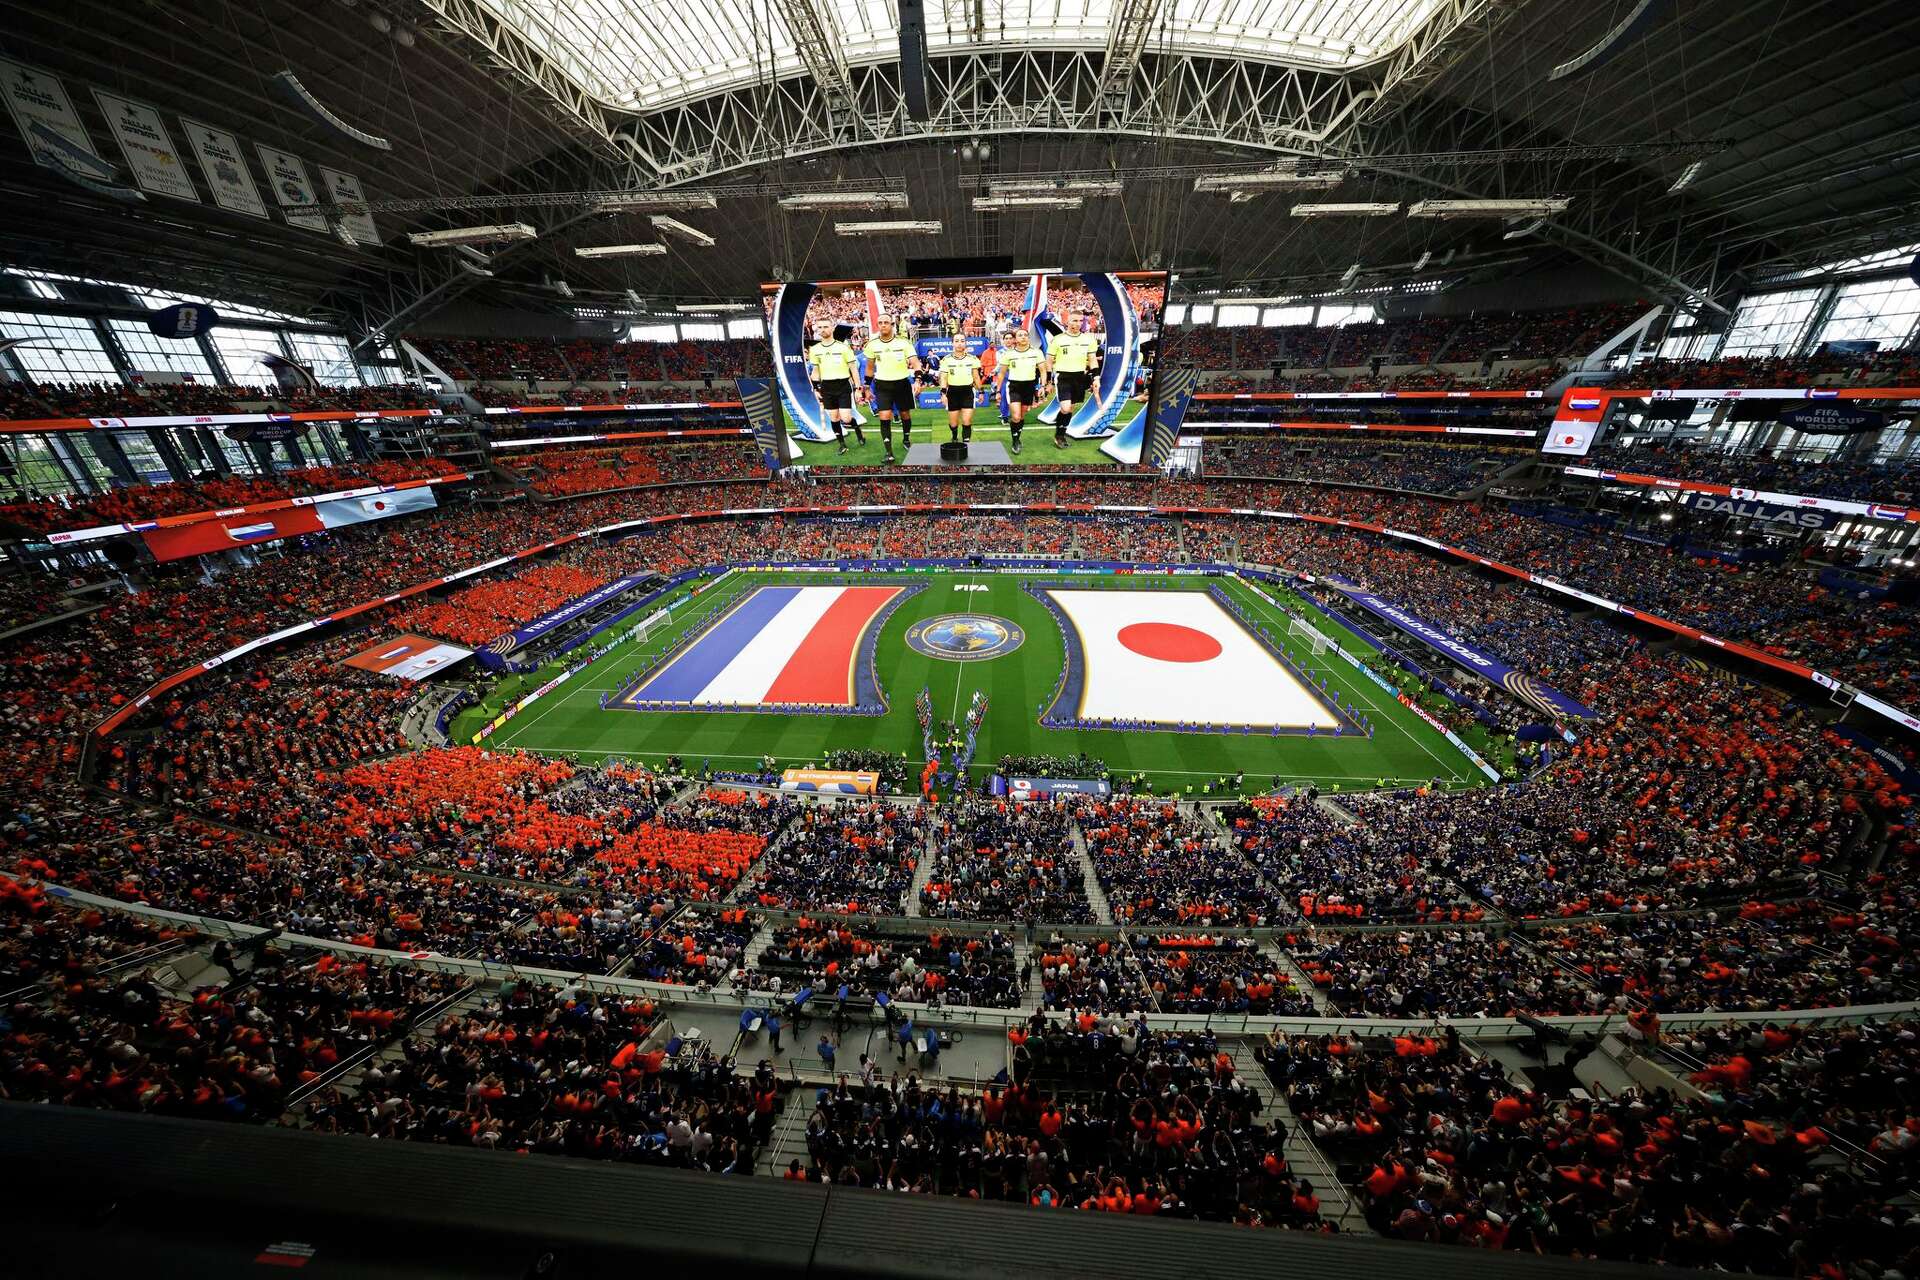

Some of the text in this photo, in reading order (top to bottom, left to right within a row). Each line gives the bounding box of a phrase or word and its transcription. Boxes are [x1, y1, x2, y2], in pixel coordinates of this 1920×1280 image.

[120, 117, 153, 131] DALLAS
[121, 124, 160, 140] COWBOYS
[203, 142, 230, 155] DALLAS
[203, 148, 237, 163] COWBOYS
[274, 165, 297, 176] DALLAS
[1108, 346, 1122, 354] FIFA
[784, 355, 803, 363] FIFA
[1815, 408, 1840, 417] FIFA
[1795, 415, 1865, 425] WORLD CUP
[1695, 497, 1825, 529] DALLAS
[51, 533, 72, 543] JAPAN
[954, 584, 989, 592] FIFA
[523, 579, 631, 633] FIFA WORLD CUP 2026
[1362, 597, 1493, 667] FIFA WORLD CUP 2026
[591, 647, 608, 661] ULTRA
[1363, 666, 1392, 693] Hisense
[536, 680, 560, 697] verizon
[1445, 687, 1456, 697] FIFA
[1409, 702, 1447, 734] McDonald's
[1093, 1038, 1099, 1049] 8
